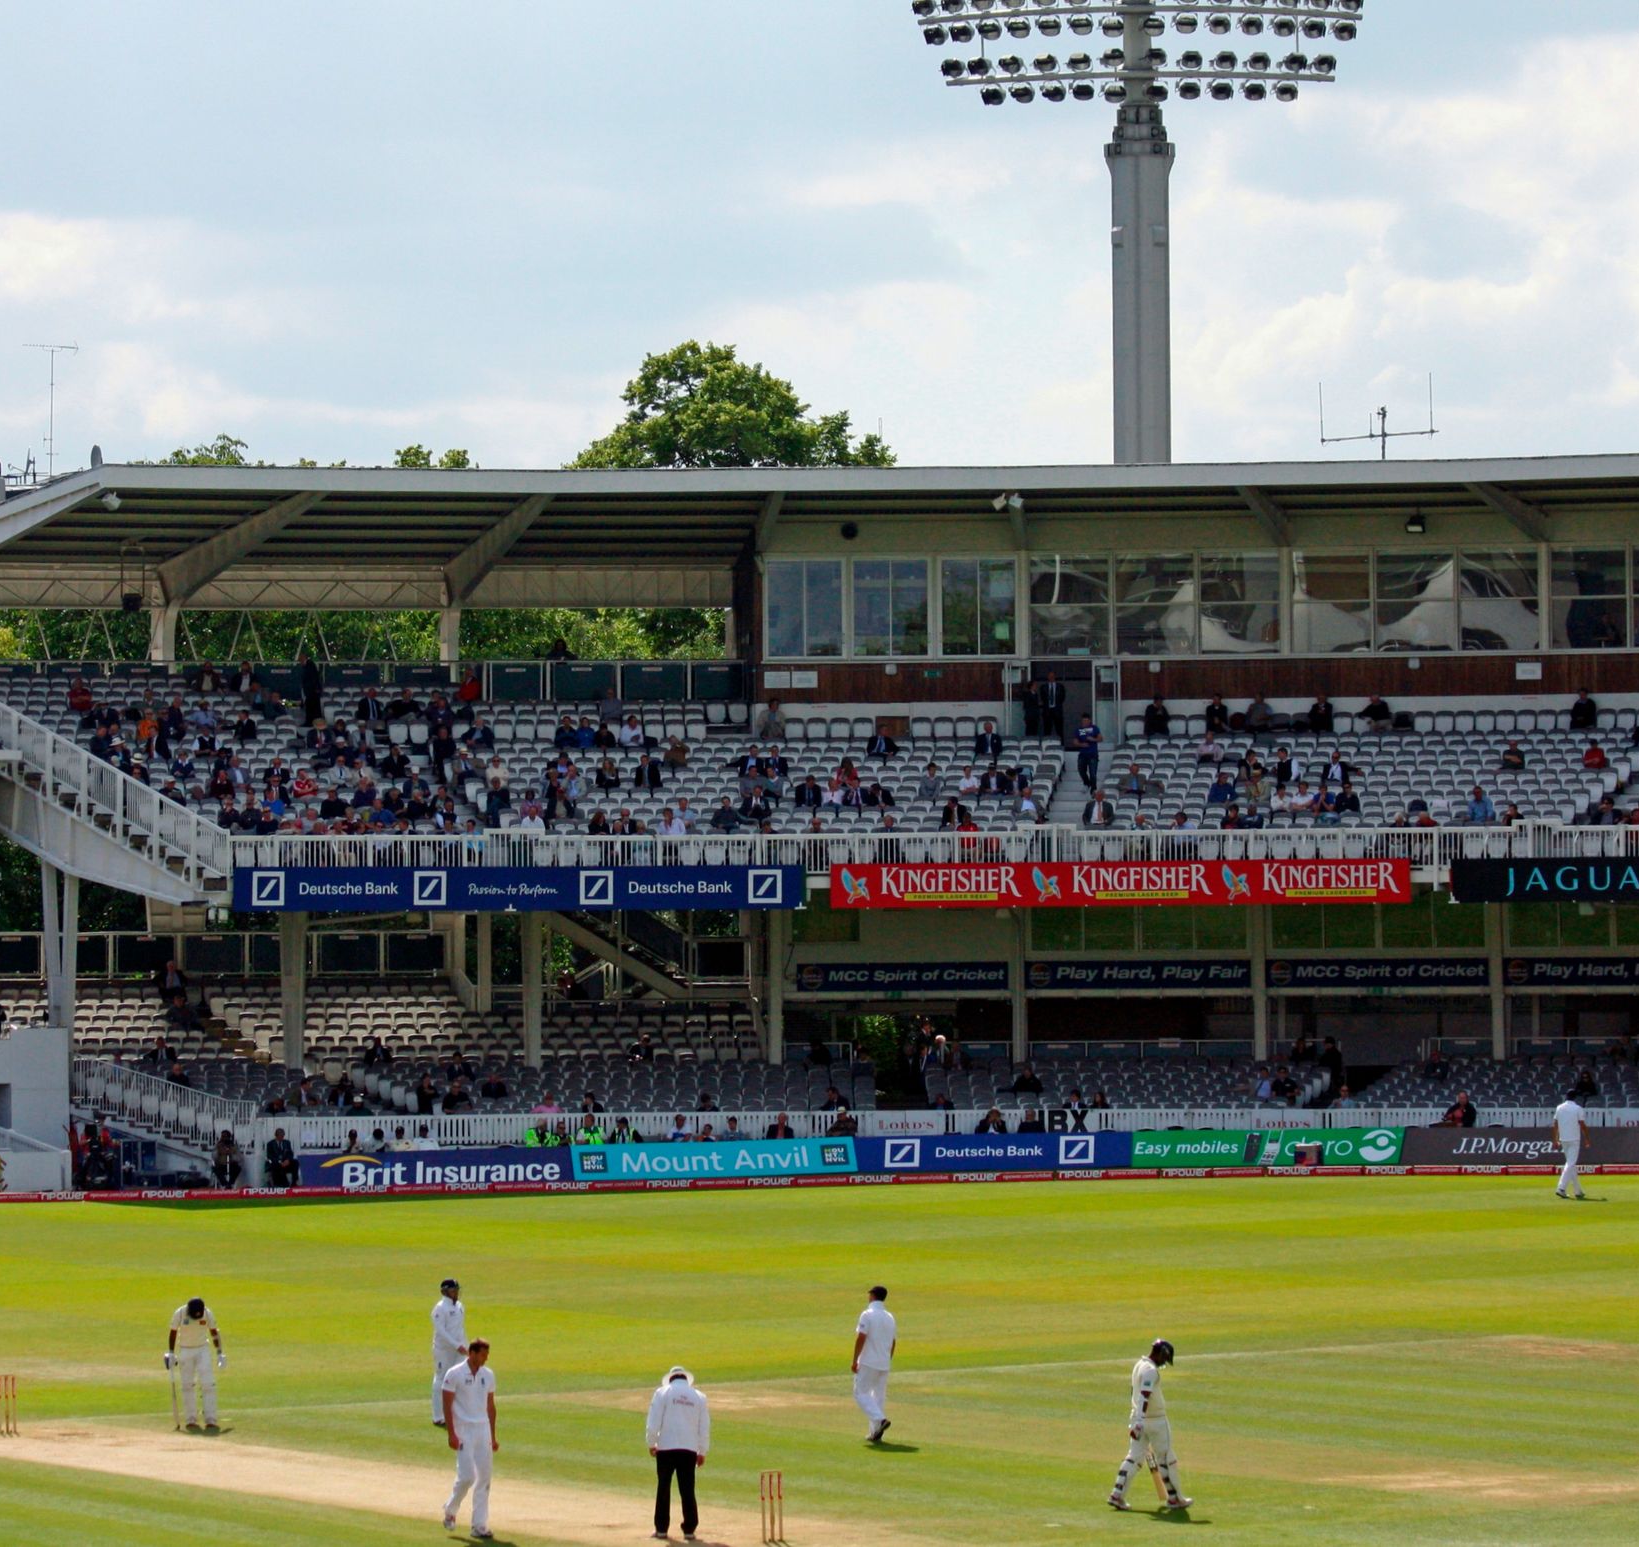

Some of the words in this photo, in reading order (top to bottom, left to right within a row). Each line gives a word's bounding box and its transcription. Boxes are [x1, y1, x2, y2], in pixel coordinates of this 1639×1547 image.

[629, 881, 694, 893] Deutsche
[698, 881, 732, 893] Bank
[882, 866, 1021, 898] KINGFISHER
[1073, 864, 1212, 899] KINGFISHER
[1264, 862, 1400, 897] KINGFISHER
[299, 882, 362, 895] Deutsche
[365, 882, 398, 894] Bank
[468, 883, 505, 895] Passion
[506, 884, 518, 895] to
[519, 883, 558, 897] Perform
[829, 971, 869, 981] MCC
[873, 970, 917, 983] Spirit
[922, 969, 939, 980] of
[943, 969, 1004, 980] Cricket
[1057, 967, 1098, 982] Play
[1103, 966, 1155, 980] Hard,
[1162, 966, 1204, 981] Play
[1209, 966, 1246, 978] Fair
[1296, 966, 1340, 978] MCC
[1344, 965, 1391, 980] Spirit
[1395, 964, 1417, 977] of
[1418, 963, 1485, 977] Cricket
[936, 1146, 1004, 1157] Deutsche
[1007, 1145, 1042, 1156] Bank
[1135, 1142, 1169, 1157] Easy
[1176, 1141, 1238, 1153] mobiles
[1285, 1137, 1353, 1157] dro
[623, 1152, 724, 1172] Mount
[735, 1146, 808, 1169] Anvil
[342, 1162, 407, 1187] Brit
[416, 1162, 560, 1184] Insurance
[748, 1177, 795, 1186] npower
[646, 1179, 693, 1188] npower
